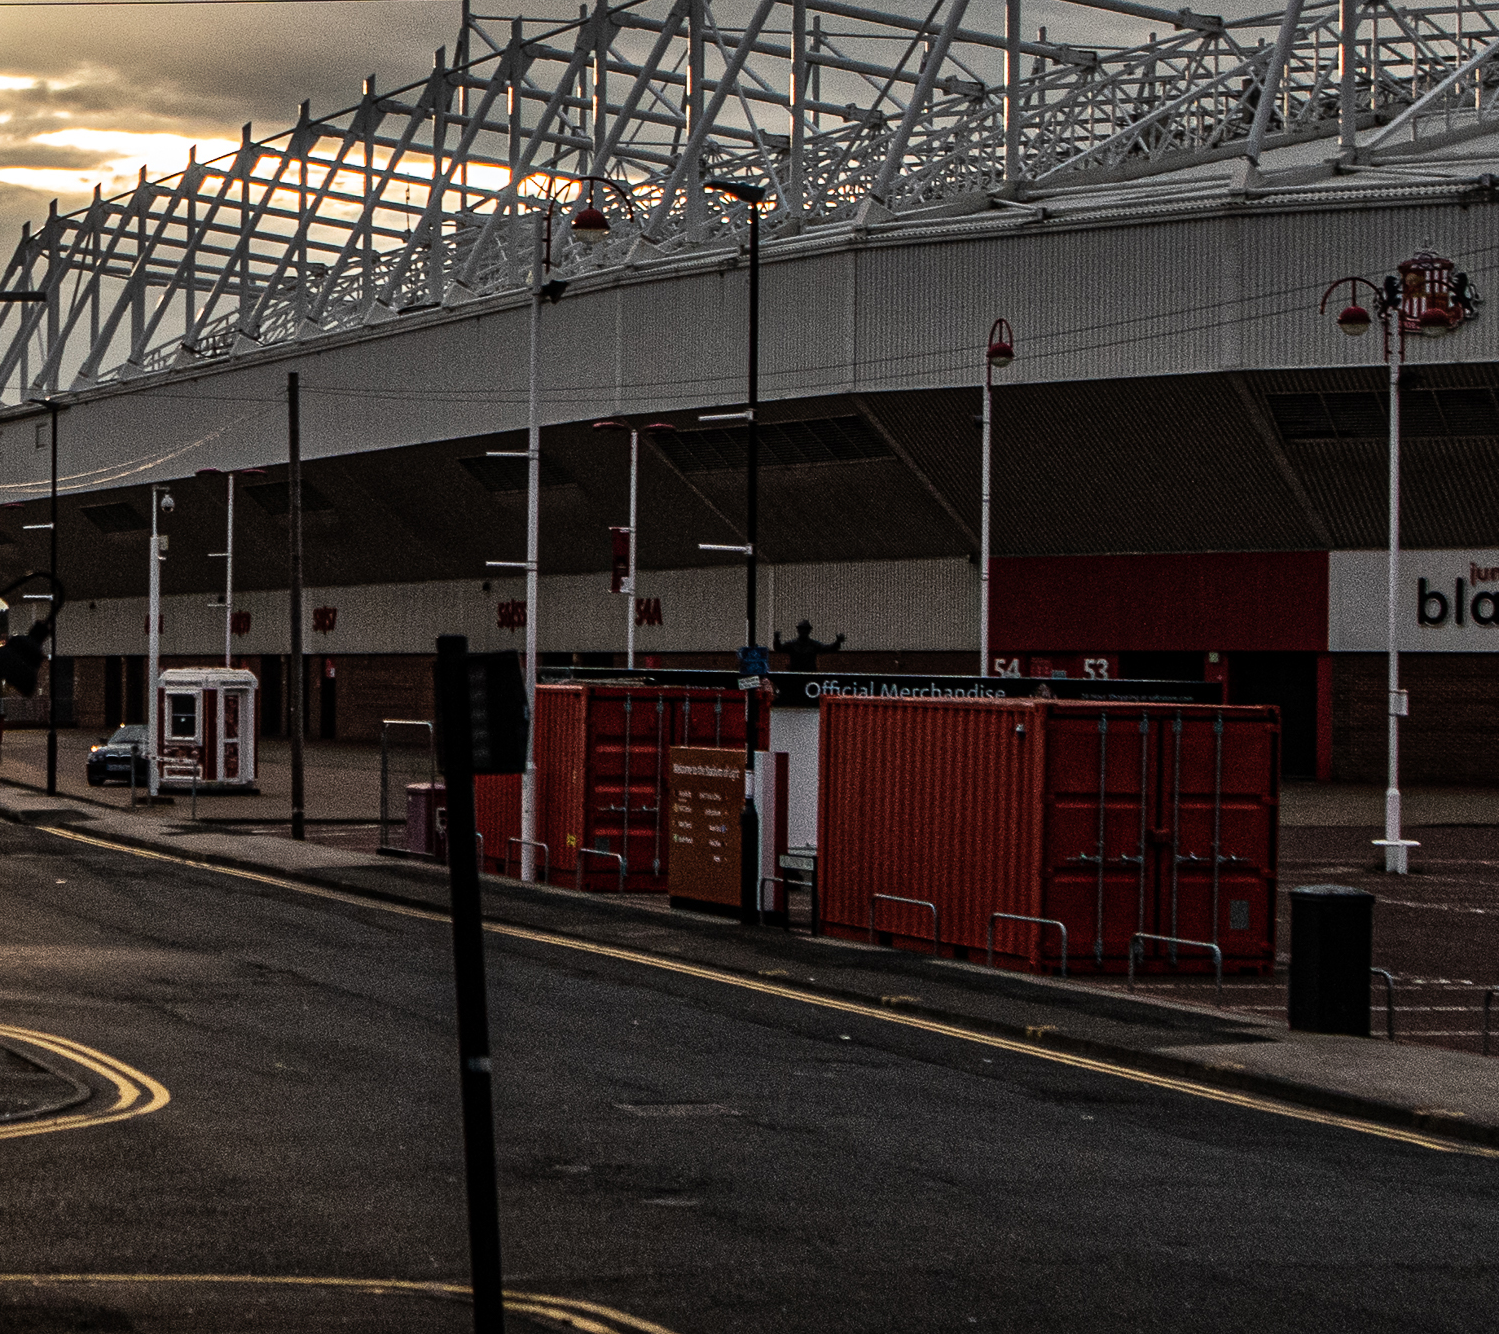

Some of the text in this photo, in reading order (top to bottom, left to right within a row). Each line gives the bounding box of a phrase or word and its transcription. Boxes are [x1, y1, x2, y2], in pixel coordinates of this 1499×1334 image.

[994, 658, 1021, 677] 54
[1083, 658, 1109, 679] 53
[804, 680, 1006, 700] Official Merchandise
